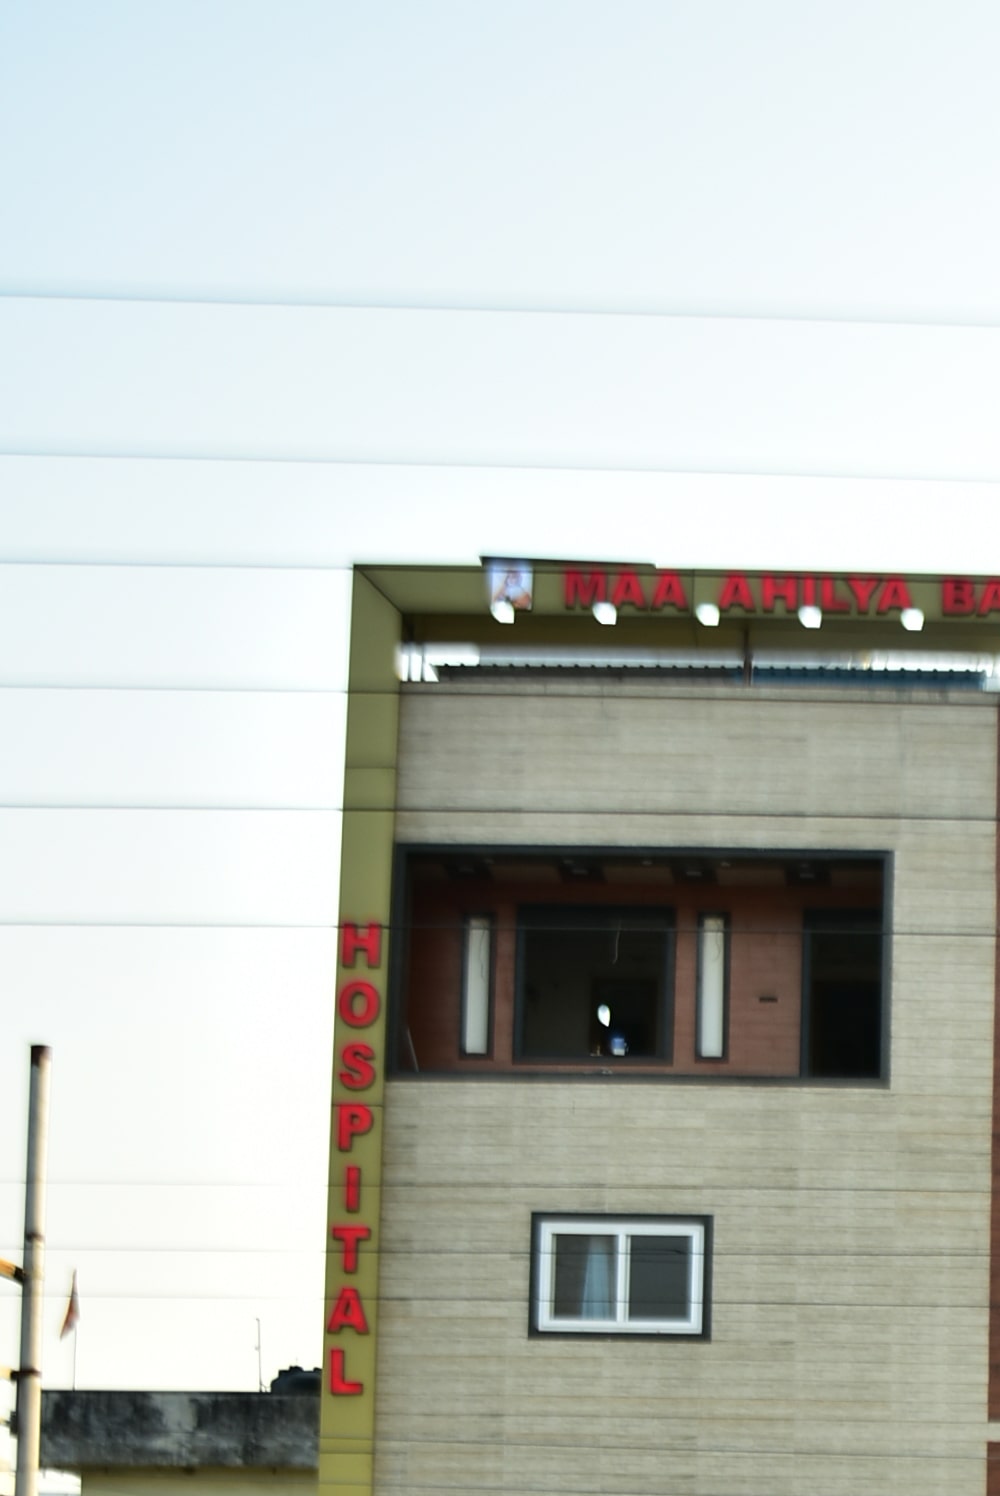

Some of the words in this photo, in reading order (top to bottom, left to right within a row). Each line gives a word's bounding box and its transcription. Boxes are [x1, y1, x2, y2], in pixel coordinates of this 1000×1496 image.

[564, 567, 689, 611] MAA
[718, 571, 914, 614] AHILYA
[326, 921, 382, 1396] HOSPITAL
